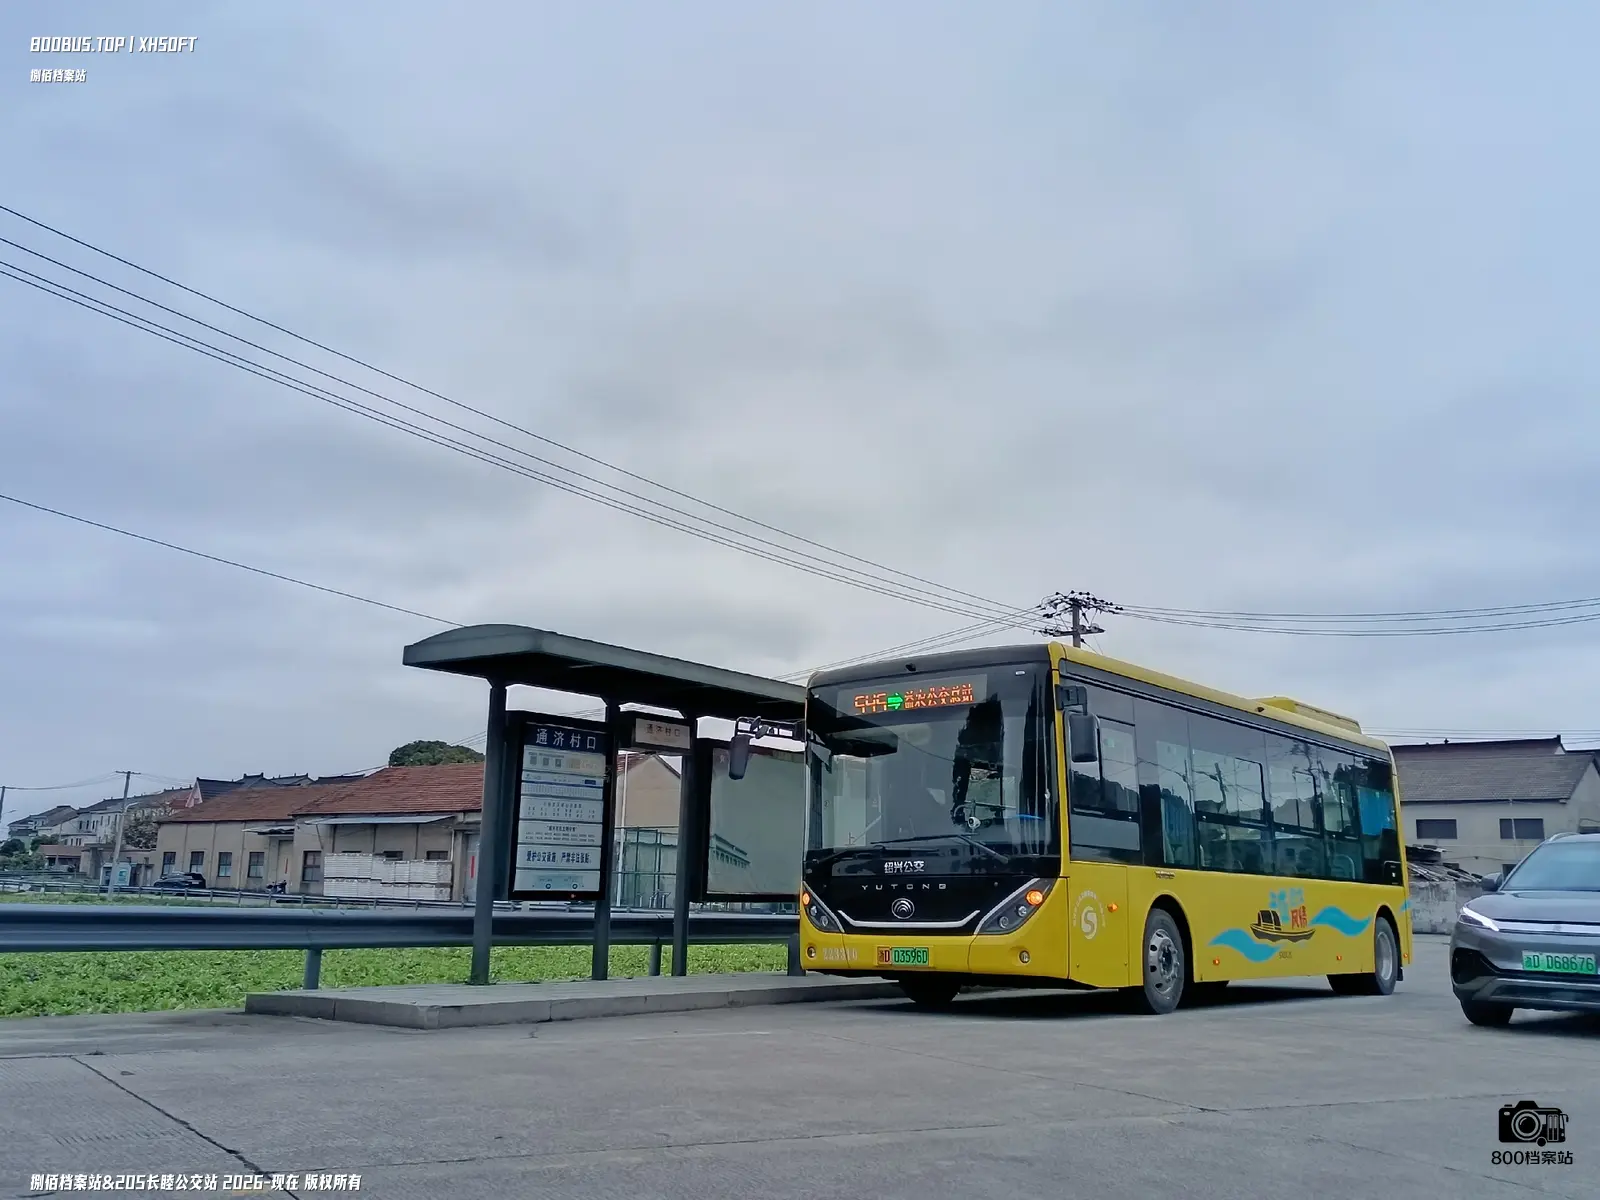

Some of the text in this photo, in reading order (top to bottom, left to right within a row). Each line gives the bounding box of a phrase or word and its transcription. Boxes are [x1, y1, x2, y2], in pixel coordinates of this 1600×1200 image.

[535, 728, 597, 750] 通济村口
[884, 860, 925, 874] 绍兴公交
[861, 883, 947, 891] YUTONG
[893, 949, 929, 964] 03596D
[1546, 954, 1594, 972] D68676
